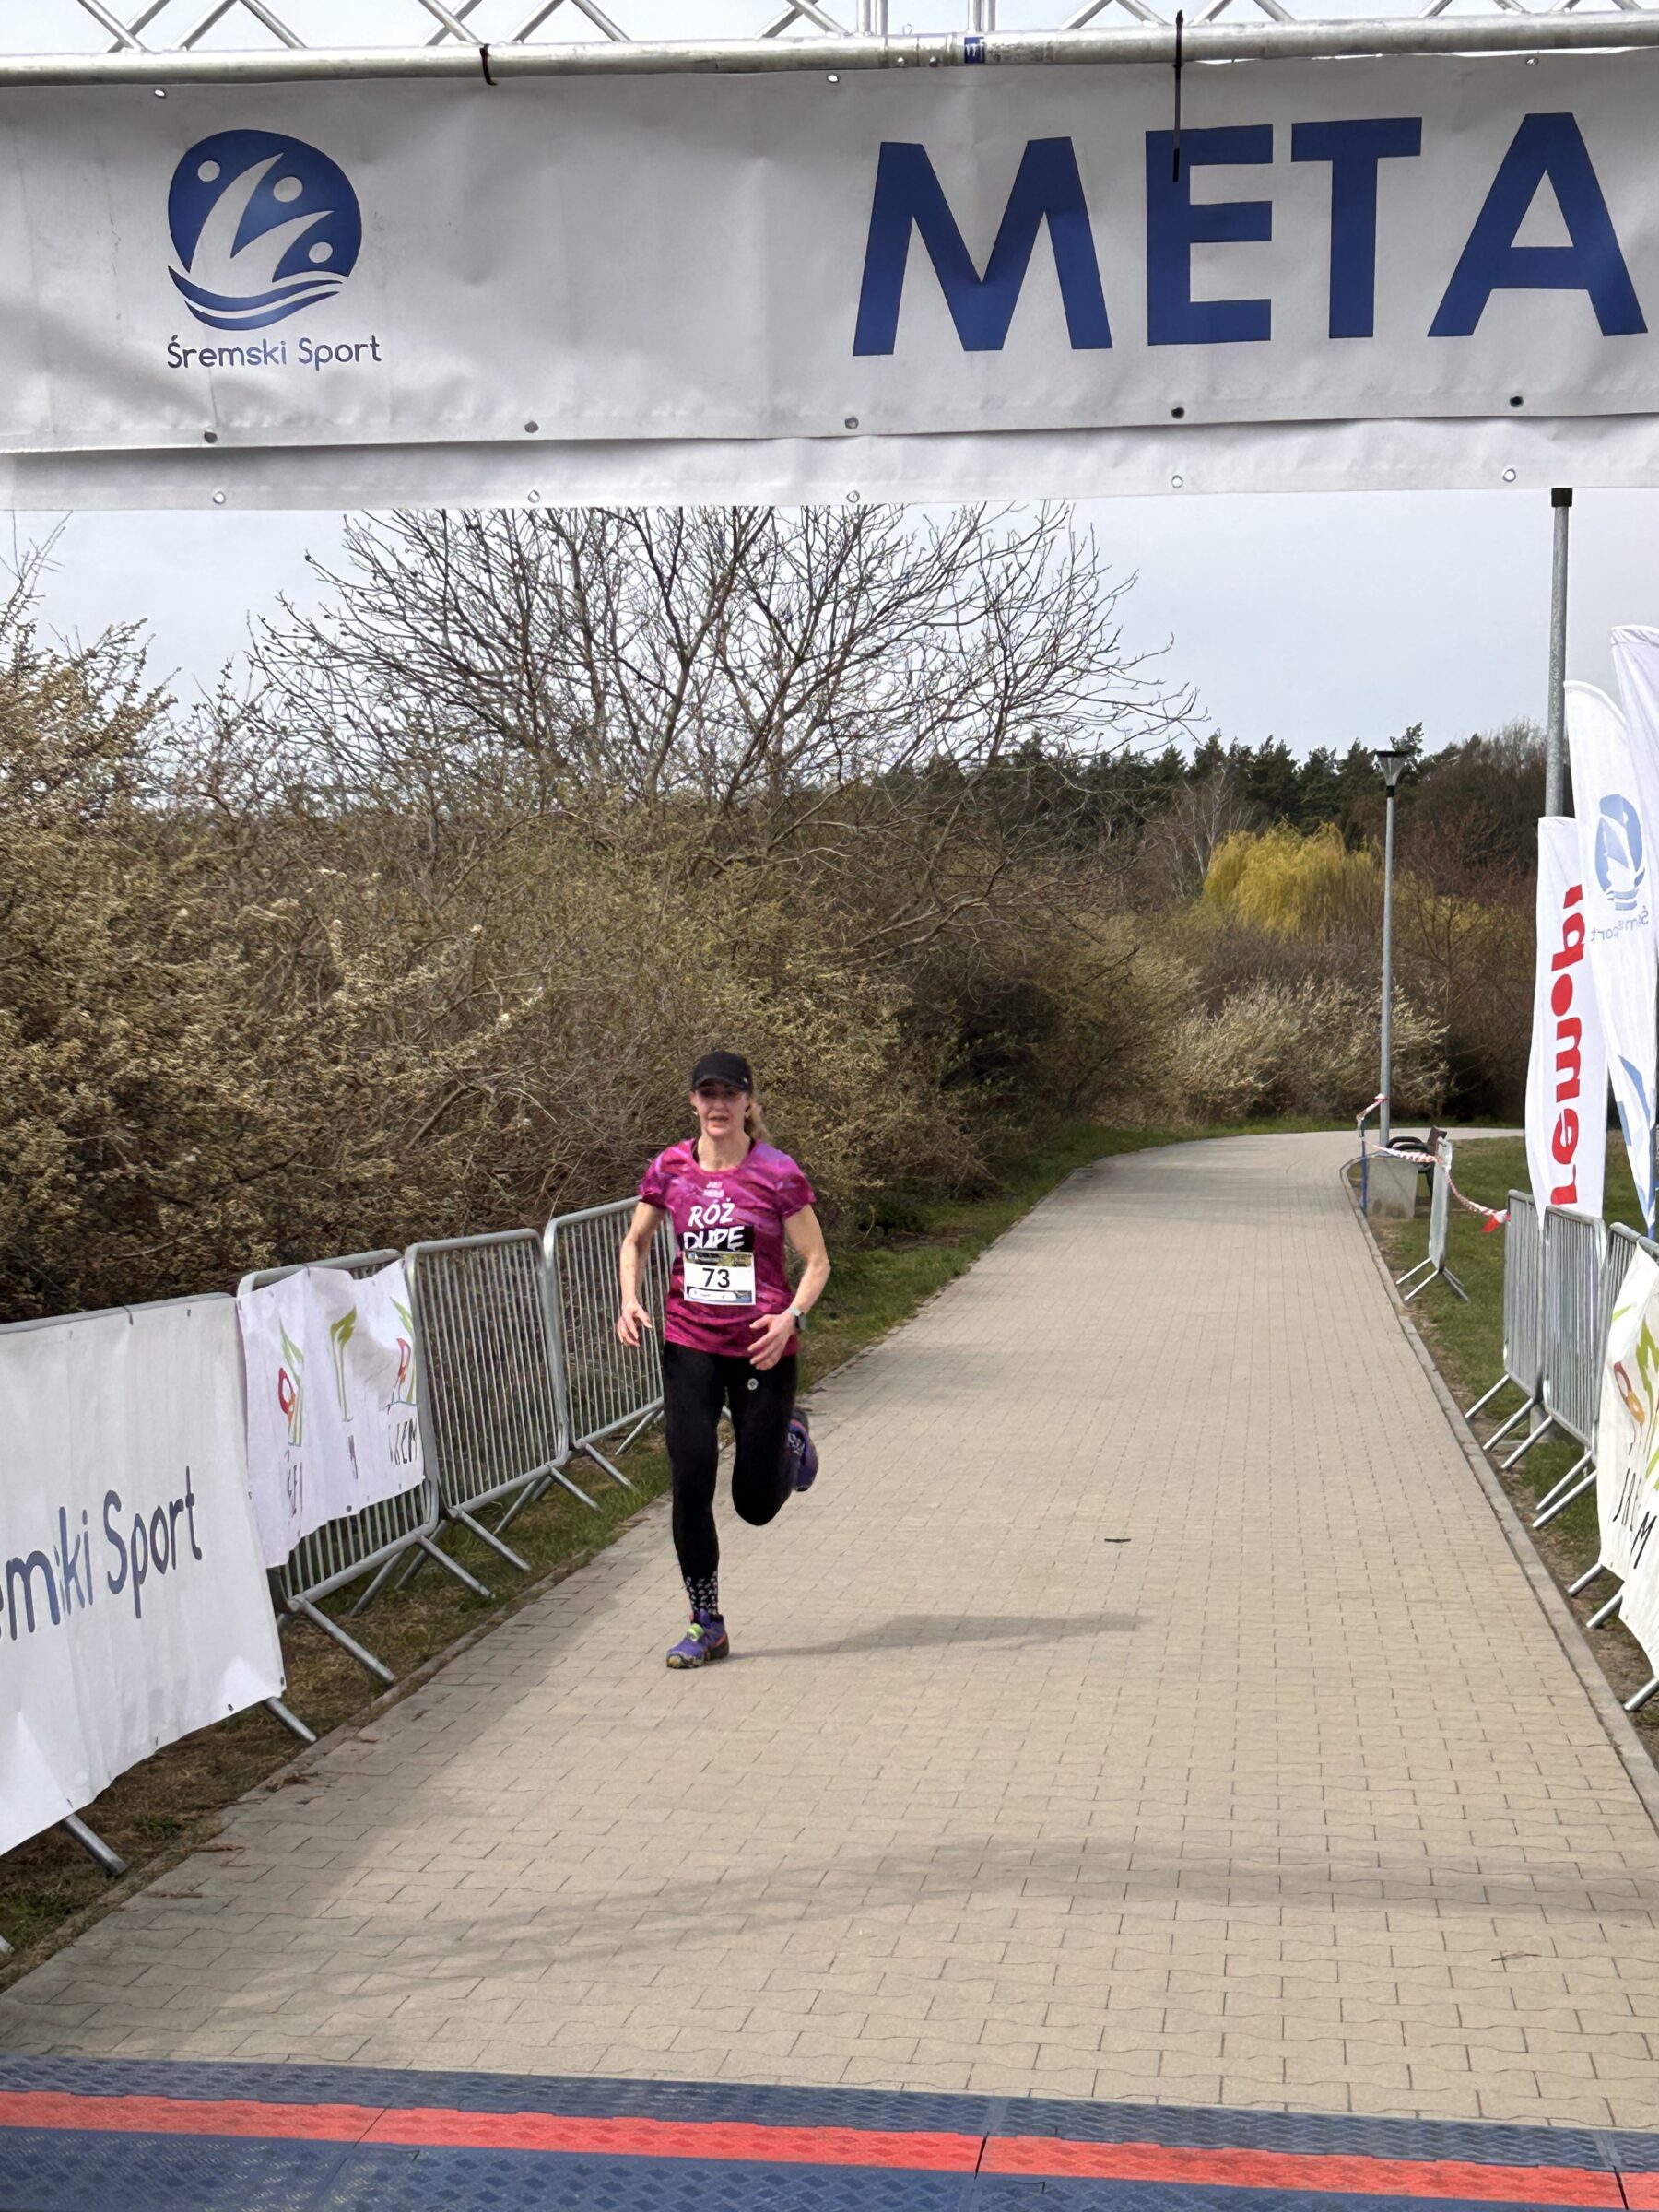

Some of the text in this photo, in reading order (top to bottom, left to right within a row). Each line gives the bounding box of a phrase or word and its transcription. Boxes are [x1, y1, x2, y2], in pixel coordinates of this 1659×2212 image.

[853, 112, 1648, 356] META
[167, 335, 382, 371] Śremski Sport
[702, 1267, 731, 1288] 73
[103, 1465, 203, 1619] Sport
